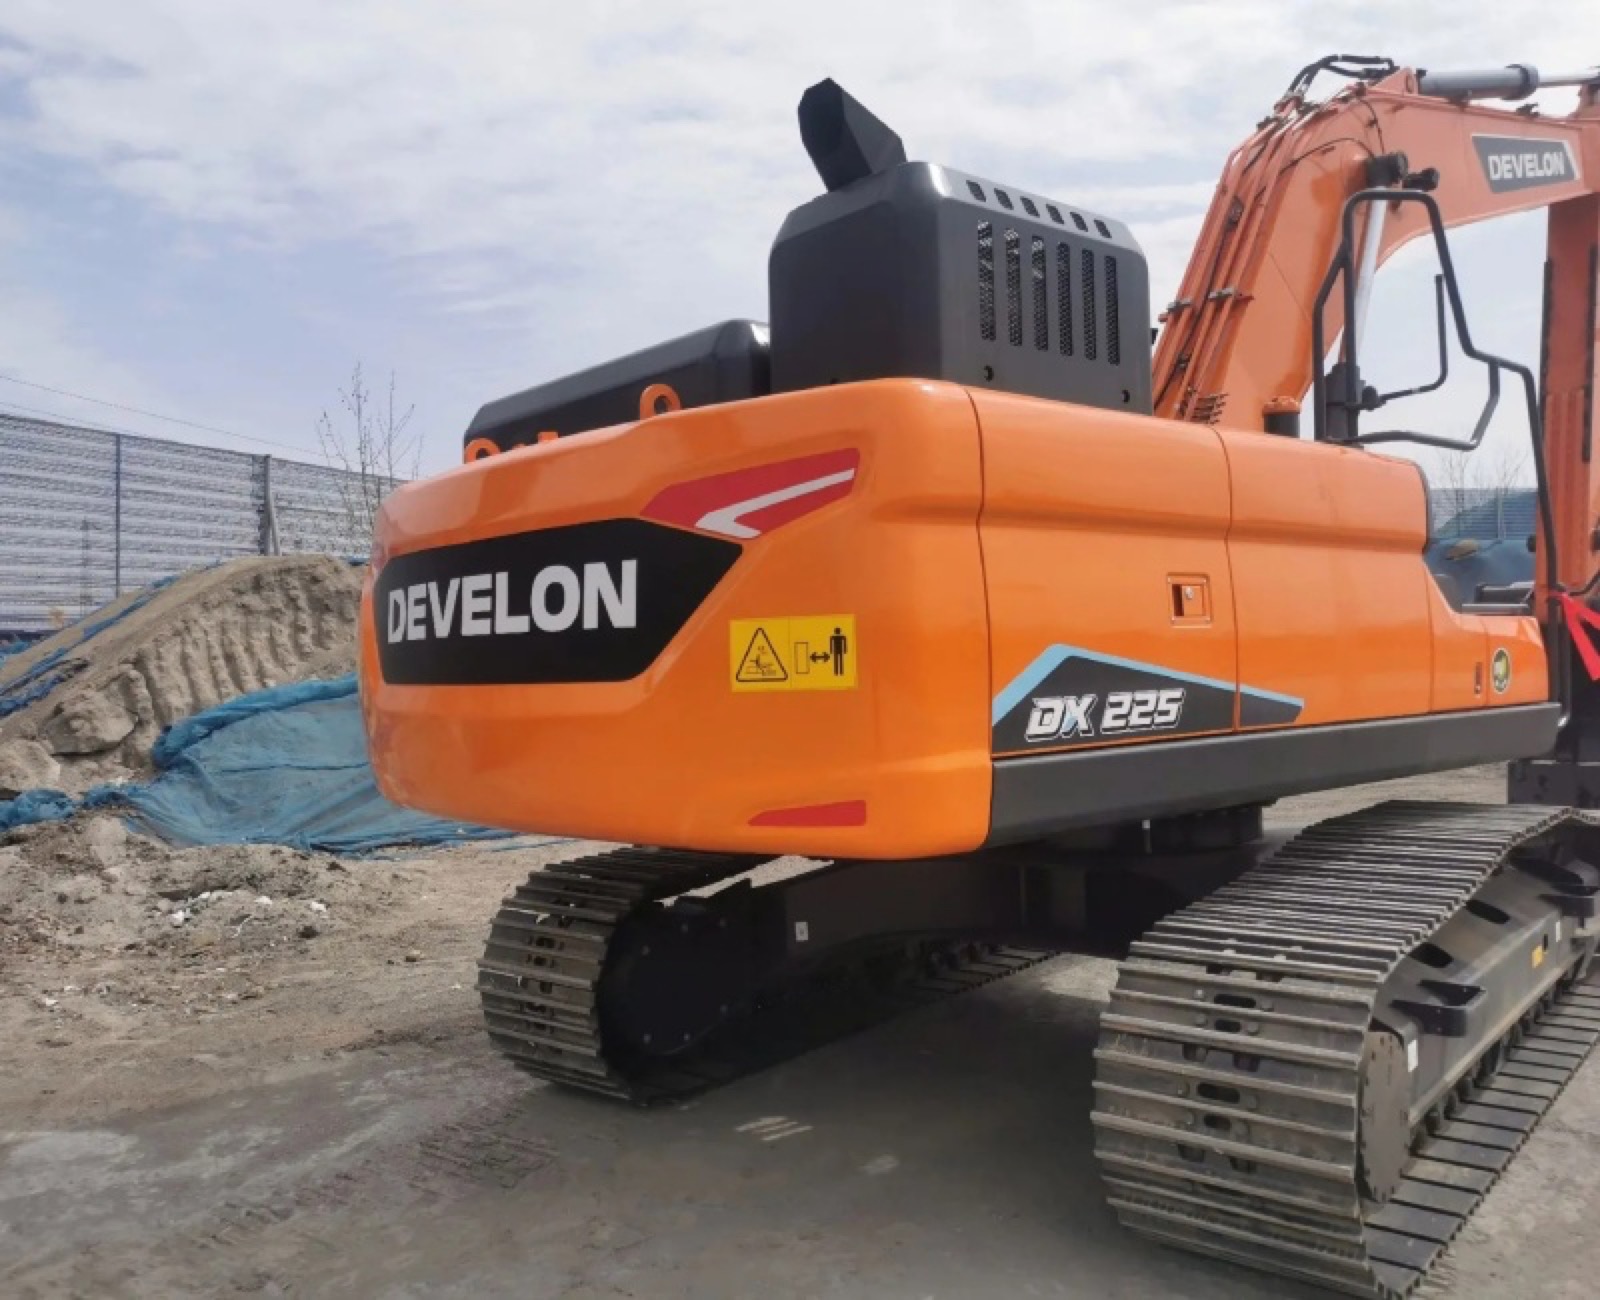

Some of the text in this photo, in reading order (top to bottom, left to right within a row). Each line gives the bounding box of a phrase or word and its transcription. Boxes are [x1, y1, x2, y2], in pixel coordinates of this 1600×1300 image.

[1487, 151, 1565, 180] DEVELON
[387, 559, 638, 644] DEVELON
[1025, 687, 1186, 742] DX 225
